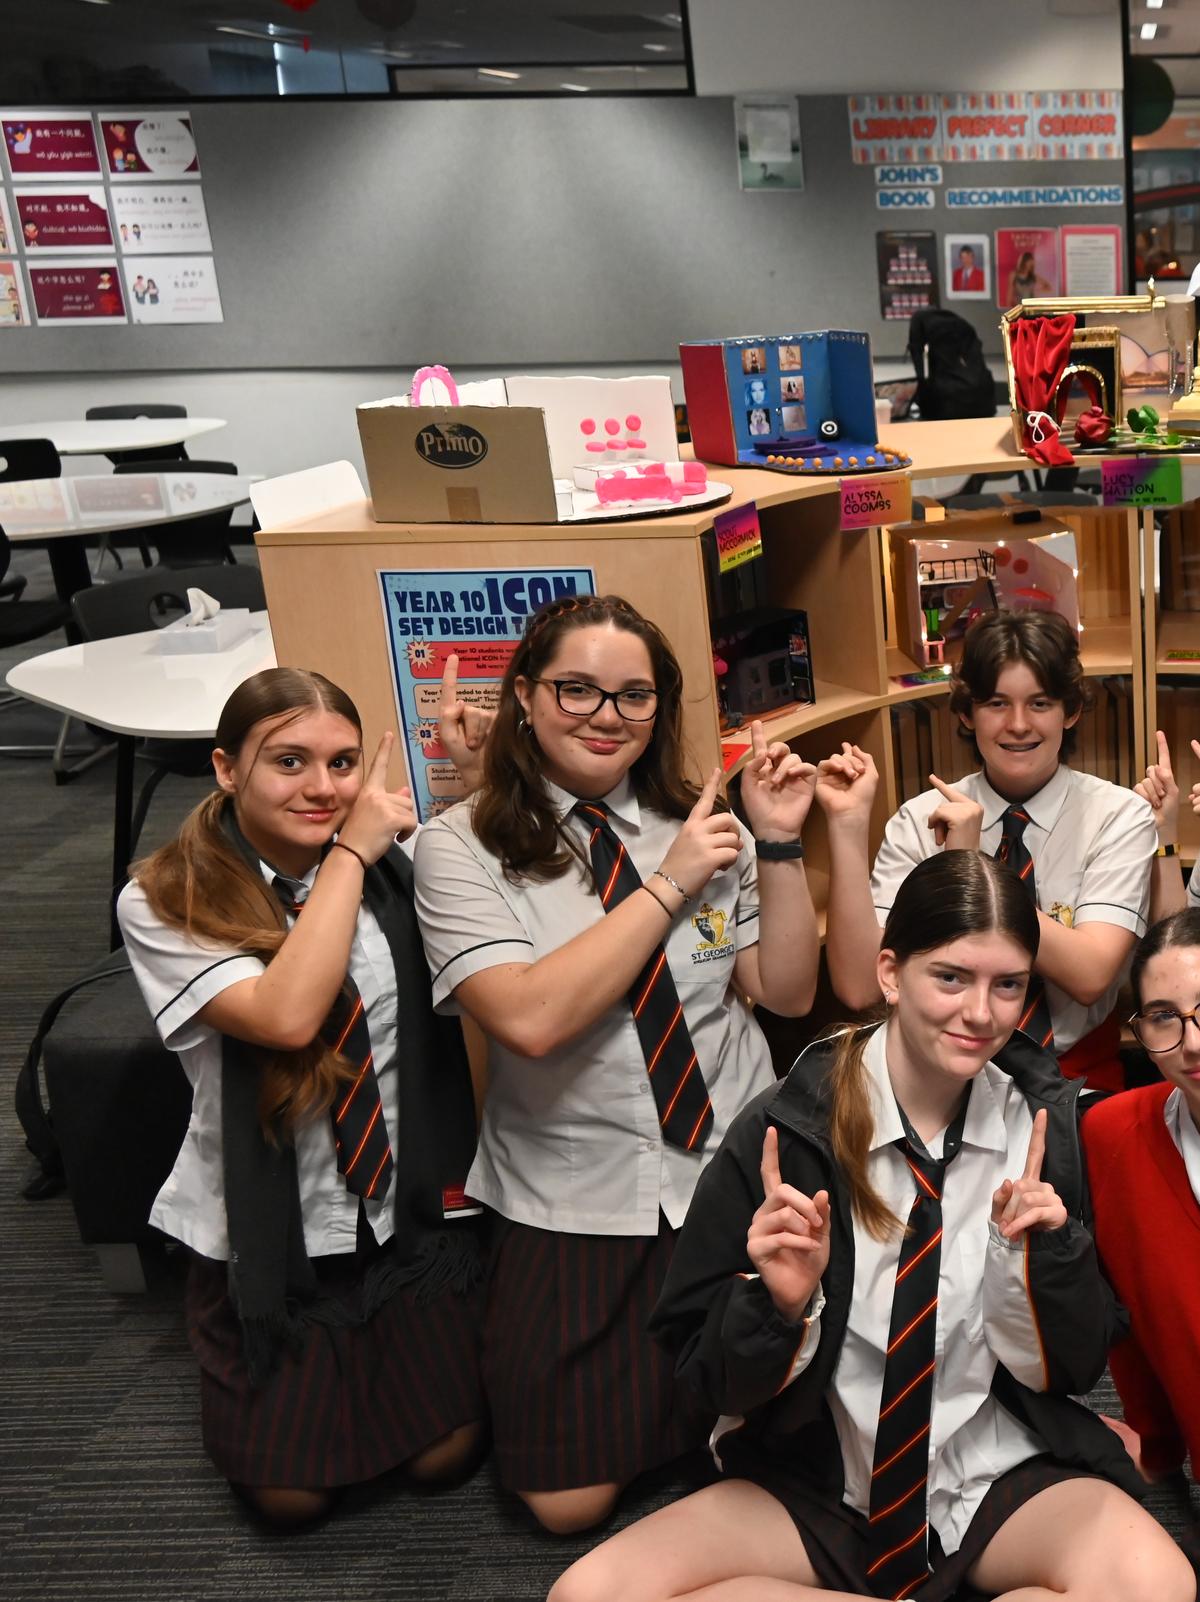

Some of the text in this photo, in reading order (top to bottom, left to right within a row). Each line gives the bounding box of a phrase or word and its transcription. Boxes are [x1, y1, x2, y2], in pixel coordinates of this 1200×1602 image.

[853, 114, 1117, 140] LIBRARY PREFECT CORNER
[878, 167, 939, 183] JOHN'S
[879, 188, 1121, 206] BOOK RECOMMENDATIONS
[421, 426, 483, 456] Primo
[844, 490, 883, 504] ALYSSA
[844, 500, 891, 514] COOMBS
[718, 525, 736, 540] SCOUT
[719, 528, 756, 553] MCCORMICK
[394, 576, 577, 615] YEAR 10 ICON
[399, 617, 434, 635] SET
[439, 616, 508, 635] DESIGN
[415, 649, 425, 658] 01
[420, 730, 431, 738] 03
[691, 952, 702, 960] ST
